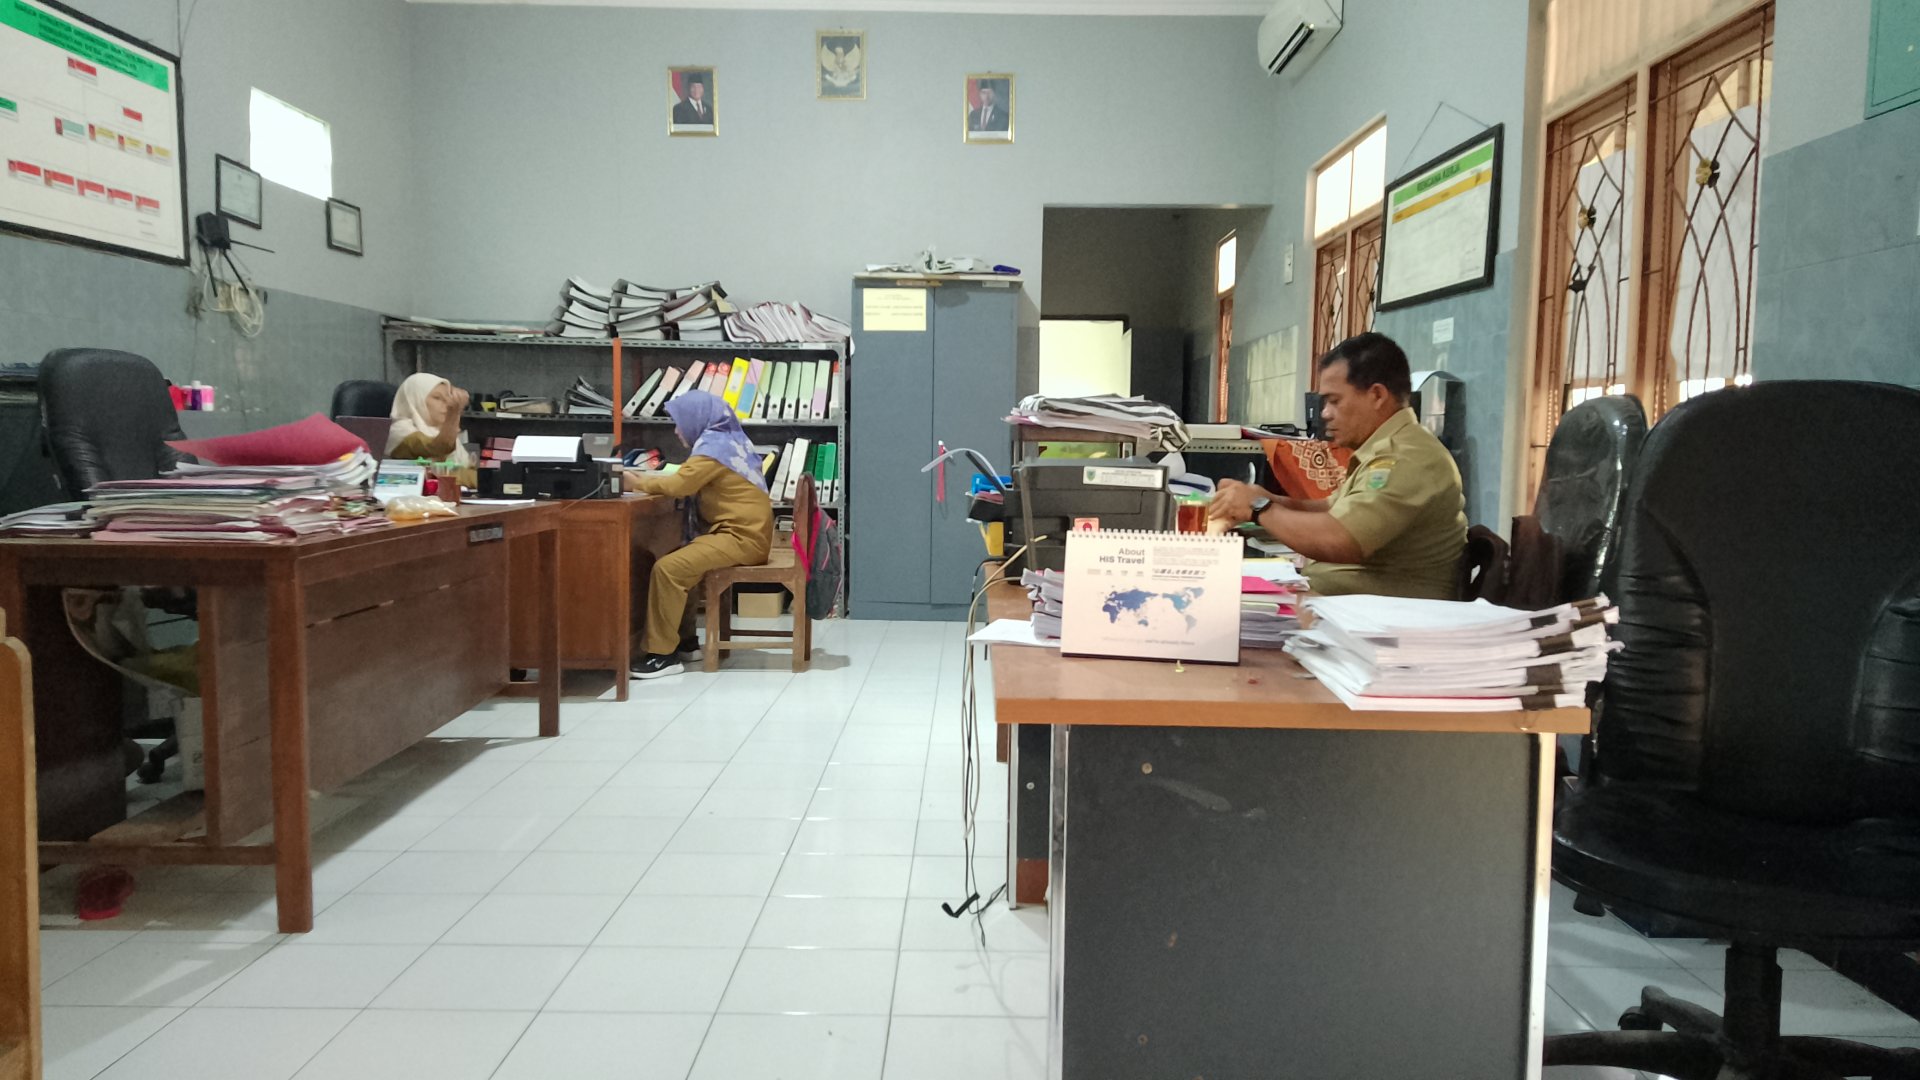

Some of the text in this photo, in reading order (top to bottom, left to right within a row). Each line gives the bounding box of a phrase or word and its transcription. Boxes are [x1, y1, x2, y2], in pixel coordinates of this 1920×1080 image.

[1118, 548, 1145, 556] About
[1099, 555, 1115, 563] HIS
[1117, 556, 1145, 564] Travel
